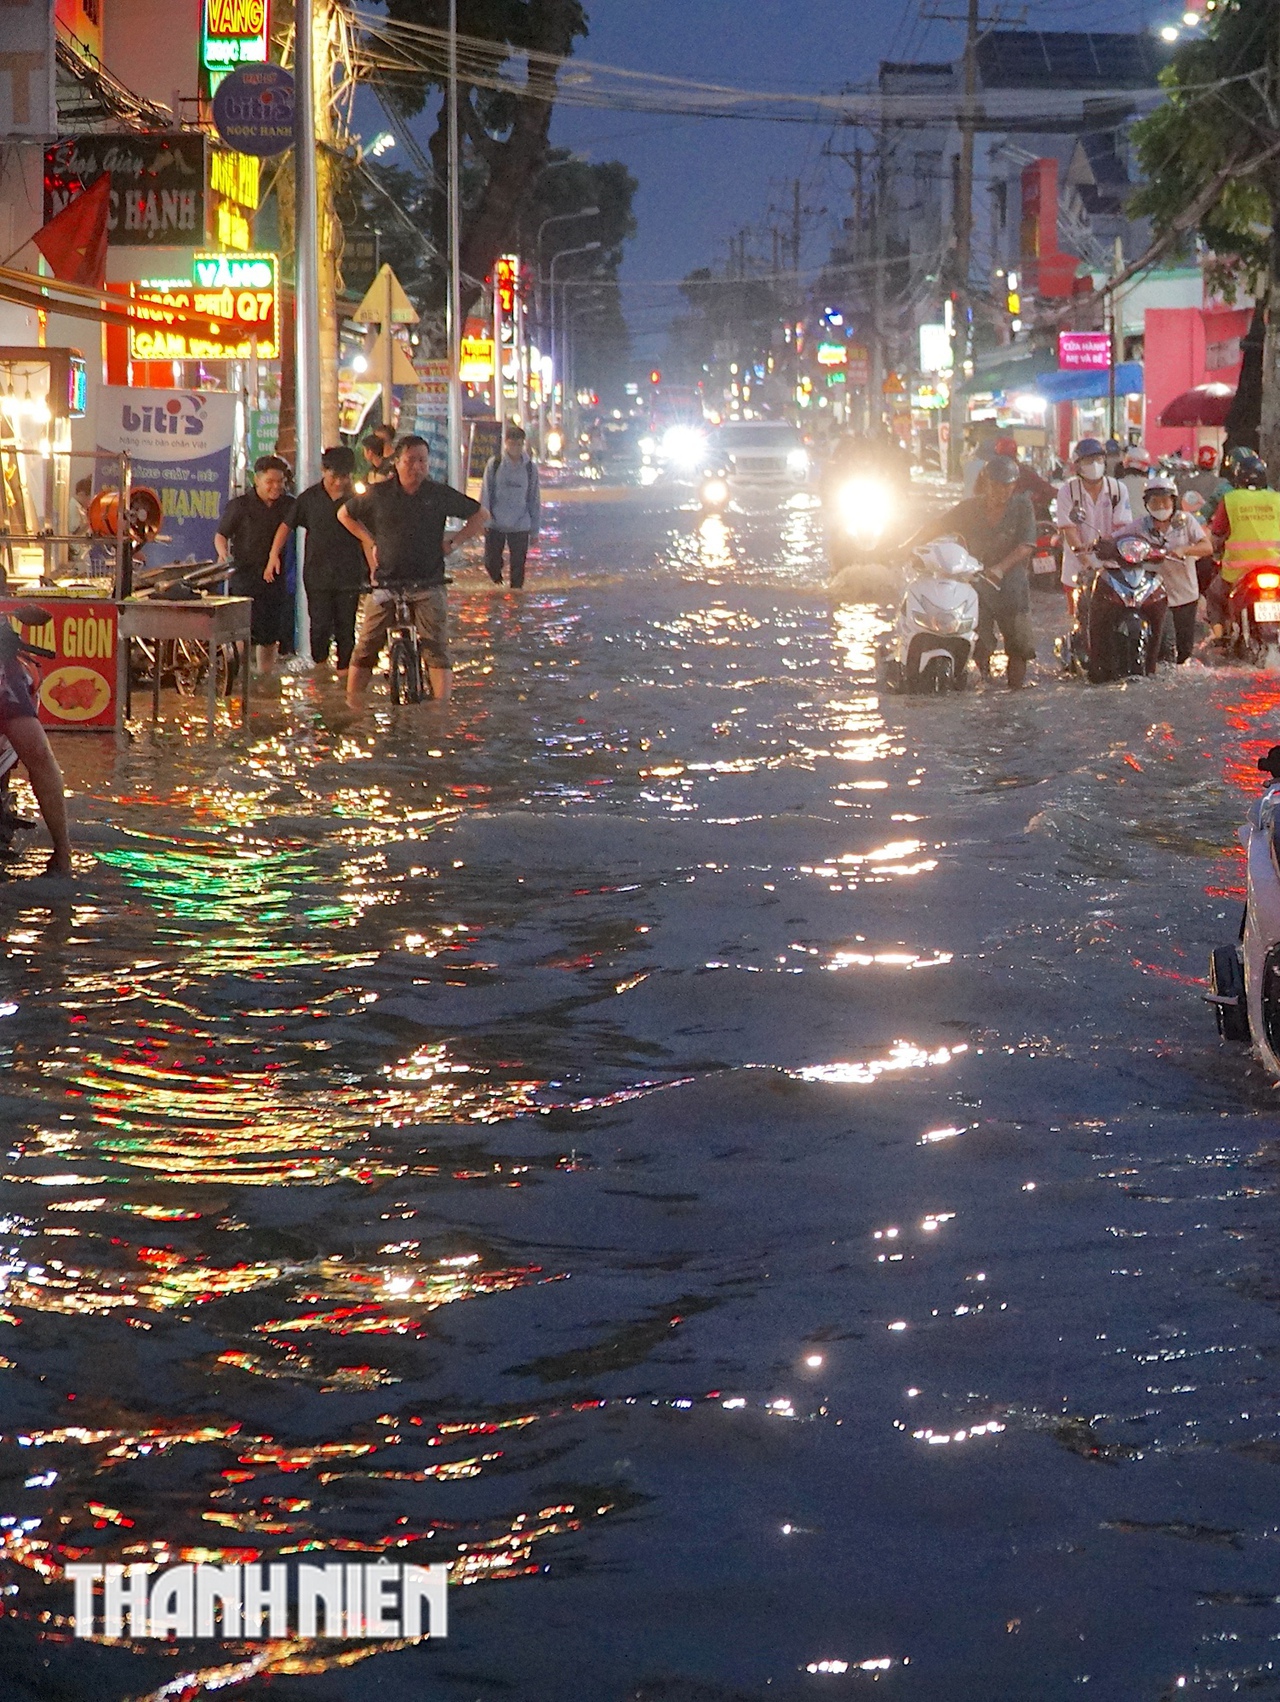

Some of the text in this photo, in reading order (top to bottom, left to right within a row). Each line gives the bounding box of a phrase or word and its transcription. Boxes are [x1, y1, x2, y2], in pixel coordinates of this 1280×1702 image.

[125, 189, 196, 239] HẠNH
[237, 291, 273, 322] Q7
[122, 399, 204, 435] biti's
[162, 486, 221, 525] HẠNH
[63, 607, 113, 658] GIÒN
